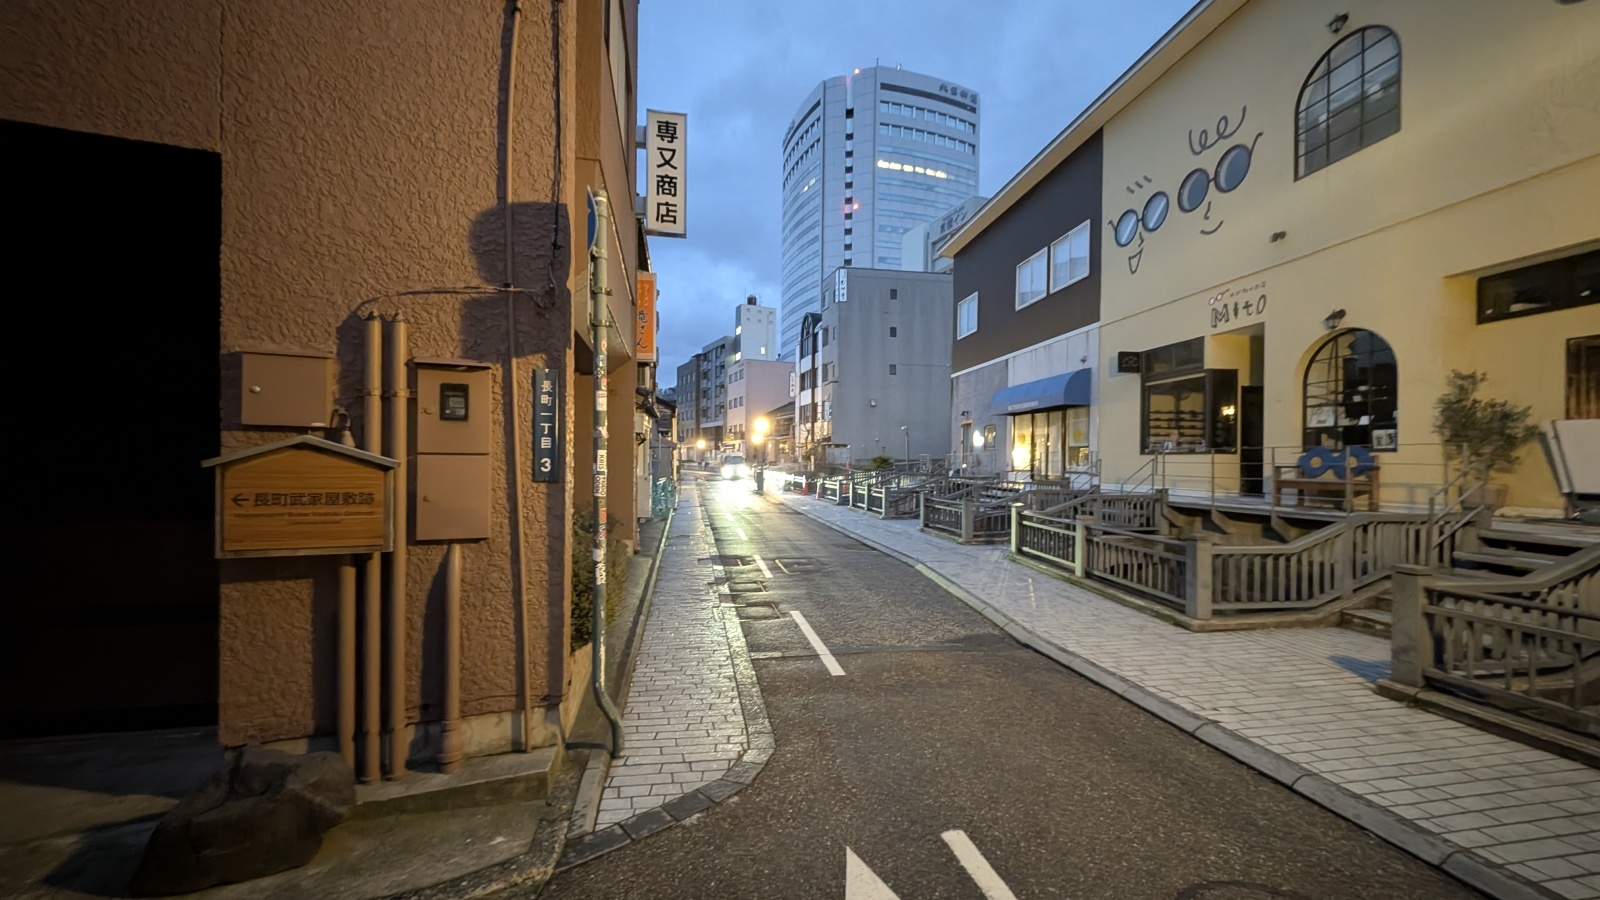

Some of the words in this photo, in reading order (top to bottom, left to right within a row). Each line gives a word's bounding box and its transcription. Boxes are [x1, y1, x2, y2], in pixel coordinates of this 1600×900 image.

[655, 120, 678, 225] 専又商店
[540, 380, 553, 449] 長町一丁目
[540, 457, 551, 472] 3
[254, 492, 376, 507] 長町武家屋敷跡
